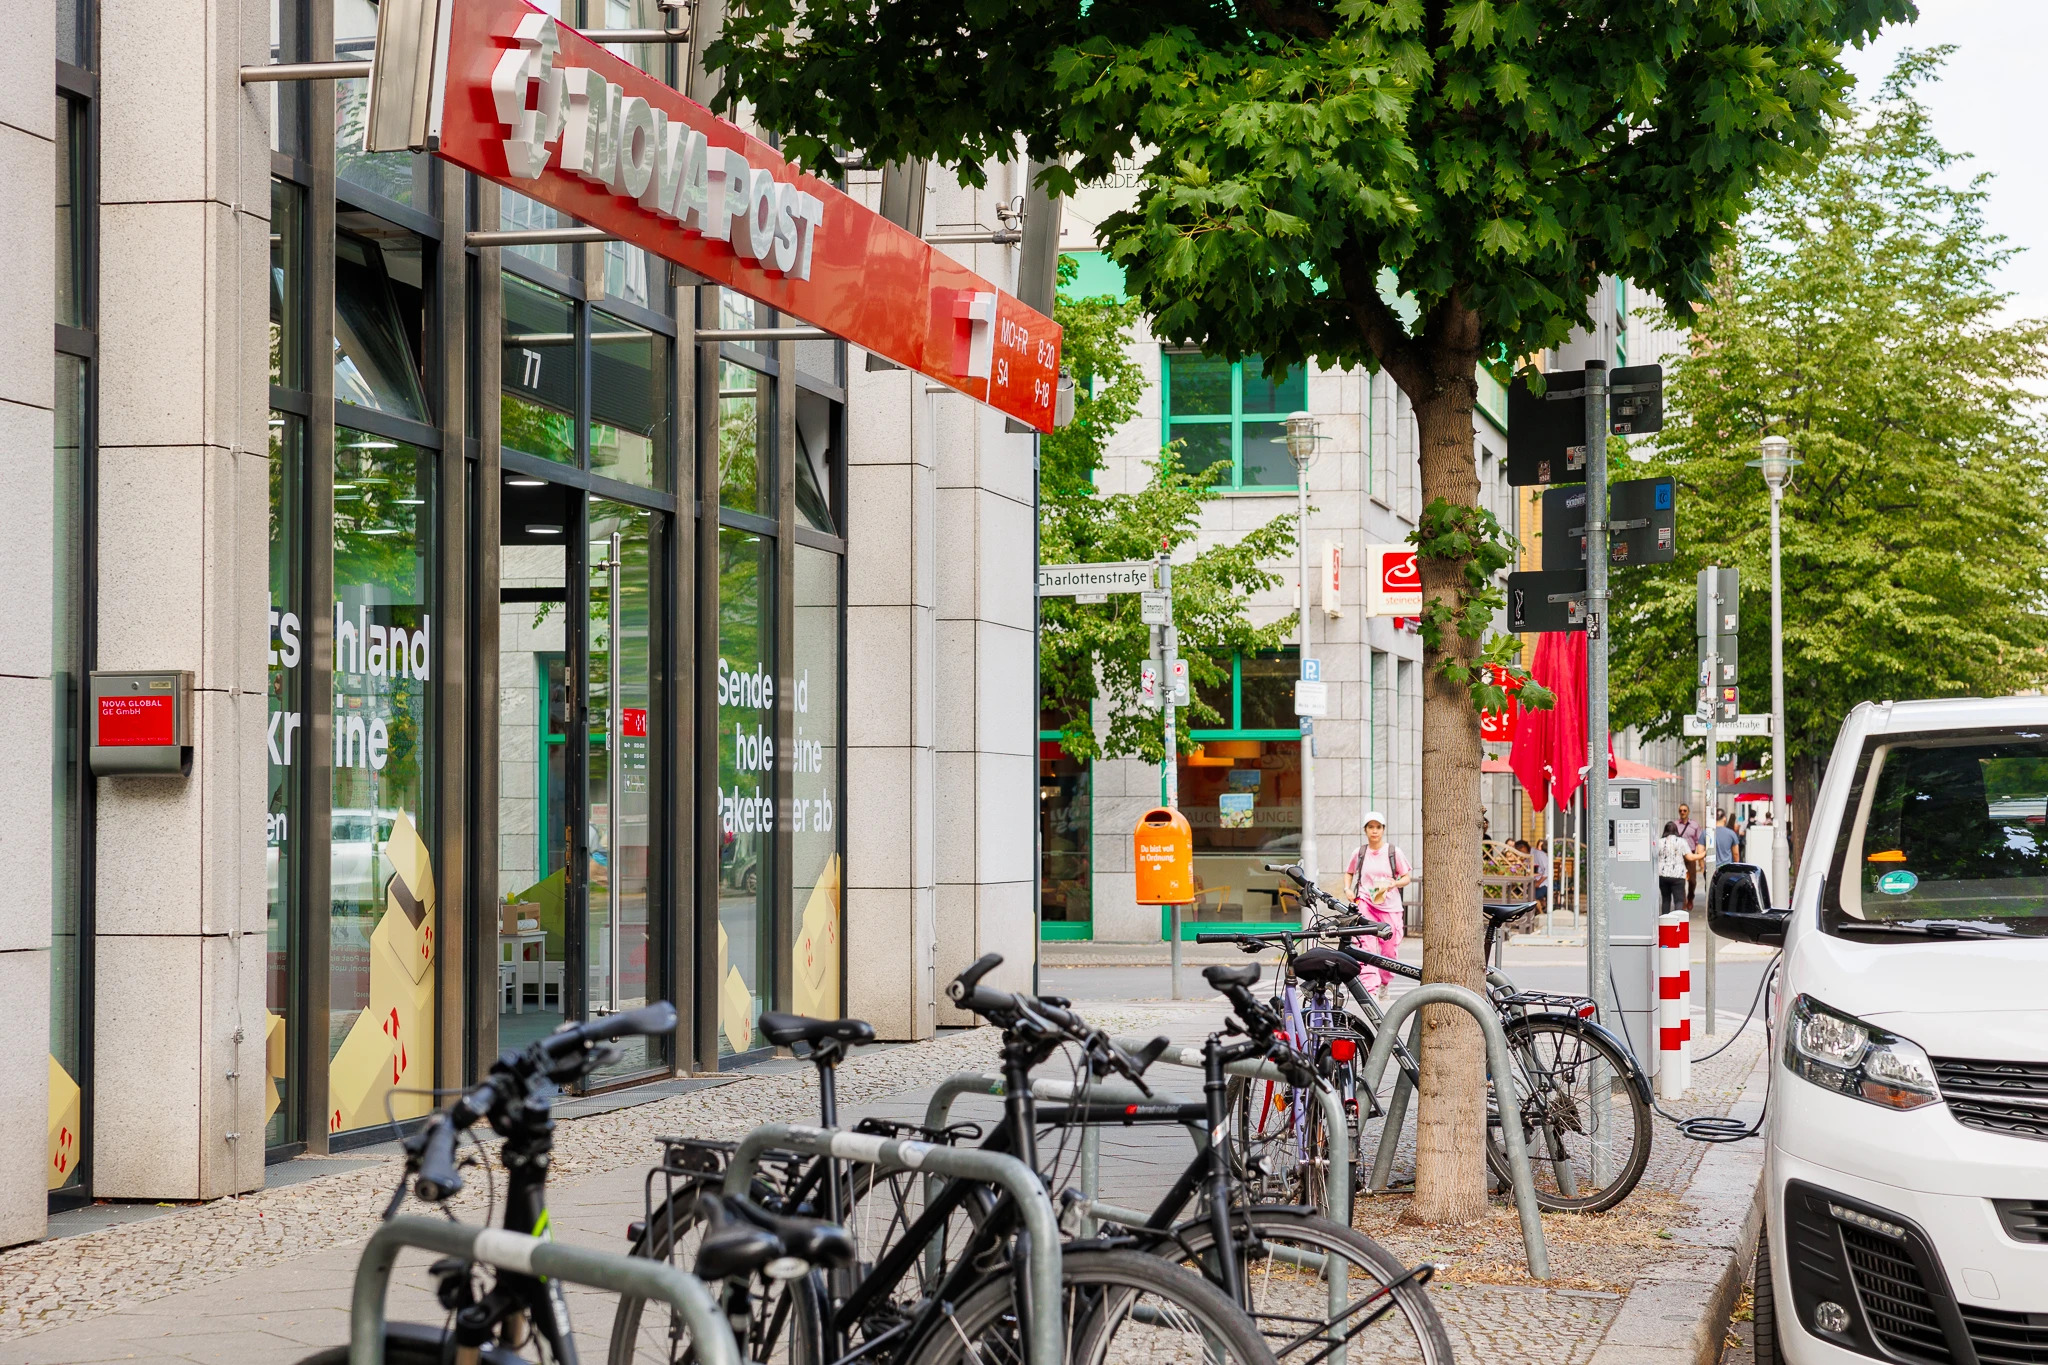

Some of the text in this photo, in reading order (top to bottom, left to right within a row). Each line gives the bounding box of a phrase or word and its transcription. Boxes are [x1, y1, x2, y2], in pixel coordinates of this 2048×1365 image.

[560, 67, 824, 282] NOVA POST
[1001, 317, 1055, 370] MO-FR 8-20
[522, 348, 541, 389] 77
[997, 358, 1050, 408] SA 9-18
[1038, 569, 1147, 586] Charlottenstraße
[718, 658, 773, 710] Sende
[102, 699, 162, 708] NOVA GLOBAL
[102, 708, 141, 716] GE GmbH
[735, 722, 773, 771] hole
[813, 788, 833, 833] ab
[1140, 843, 1174, 853] Du bist voll
[1140, 853, 1146, 862] in
[1893, 873, 1904, 883] 4
[1380, 959, 1421, 978] 3500 CROS
